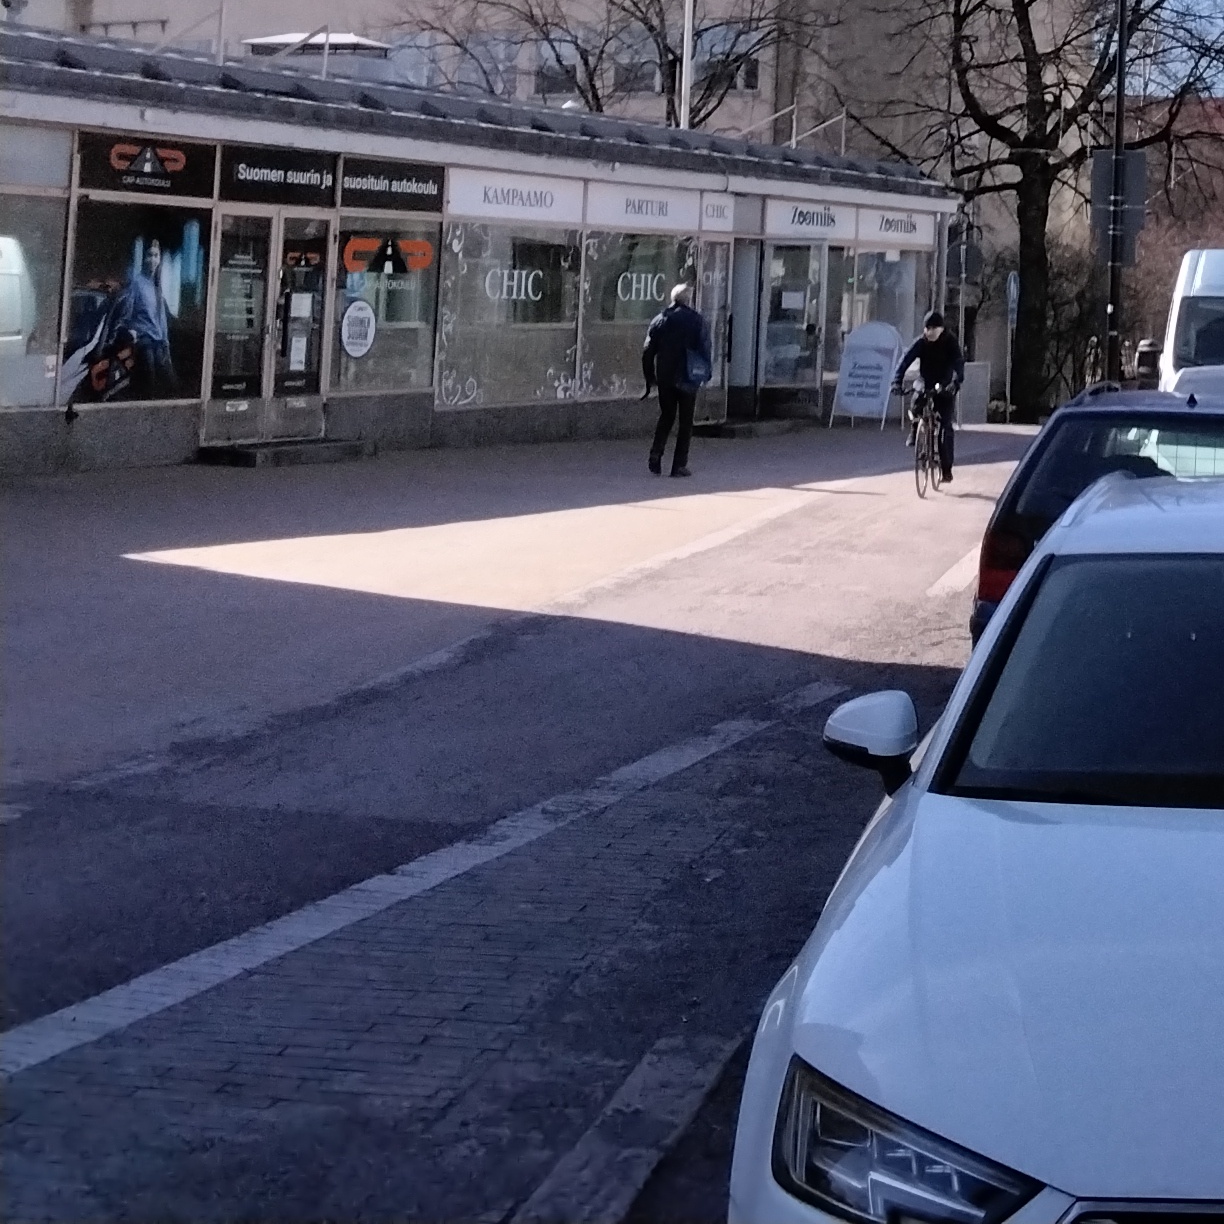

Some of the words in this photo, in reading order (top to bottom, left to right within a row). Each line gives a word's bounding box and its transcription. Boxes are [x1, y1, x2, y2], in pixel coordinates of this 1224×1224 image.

[238, 163, 284, 183] Suomen
[286, 169, 320, 187] suurin
[321, 172, 332, 189] ja
[343, 174, 388, 192] suosituin
[391, 178, 437, 195] autokoulu
[483, 185, 554, 208] KAMPAAMO
[625, 197, 668, 217] PARTURI
[705, 202, 729, 219] CHIC
[485, 268, 543, 301] CHIC
[617, 271, 666, 302] CHIC
